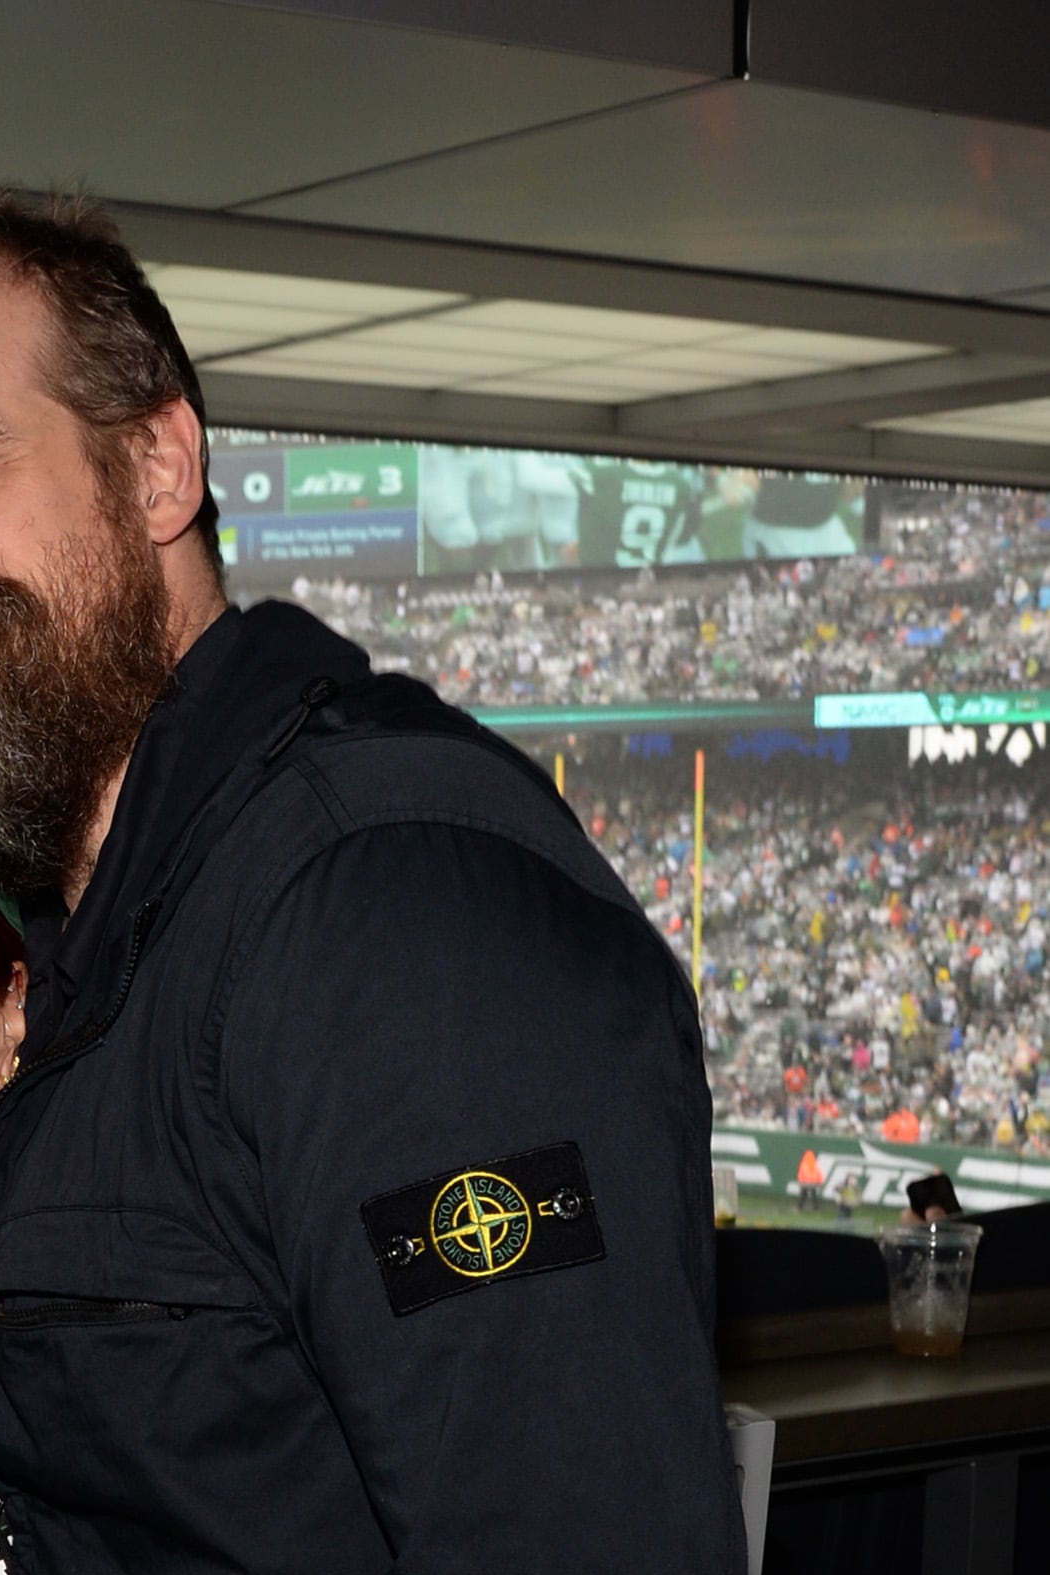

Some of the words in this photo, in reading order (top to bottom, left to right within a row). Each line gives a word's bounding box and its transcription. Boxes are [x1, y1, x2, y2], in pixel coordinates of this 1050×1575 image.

[243, 474, 272, 503] 0
[290, 469, 365, 497] JETS
[378, 464, 403, 496] 3
[615, 503, 666, 569] 9
[437, 1185, 466, 1229] STONE
[473, 1178, 521, 1212] ISLAND
[442, 1238, 485, 1270] ISLAND
[493, 1220, 526, 1263] STONE
